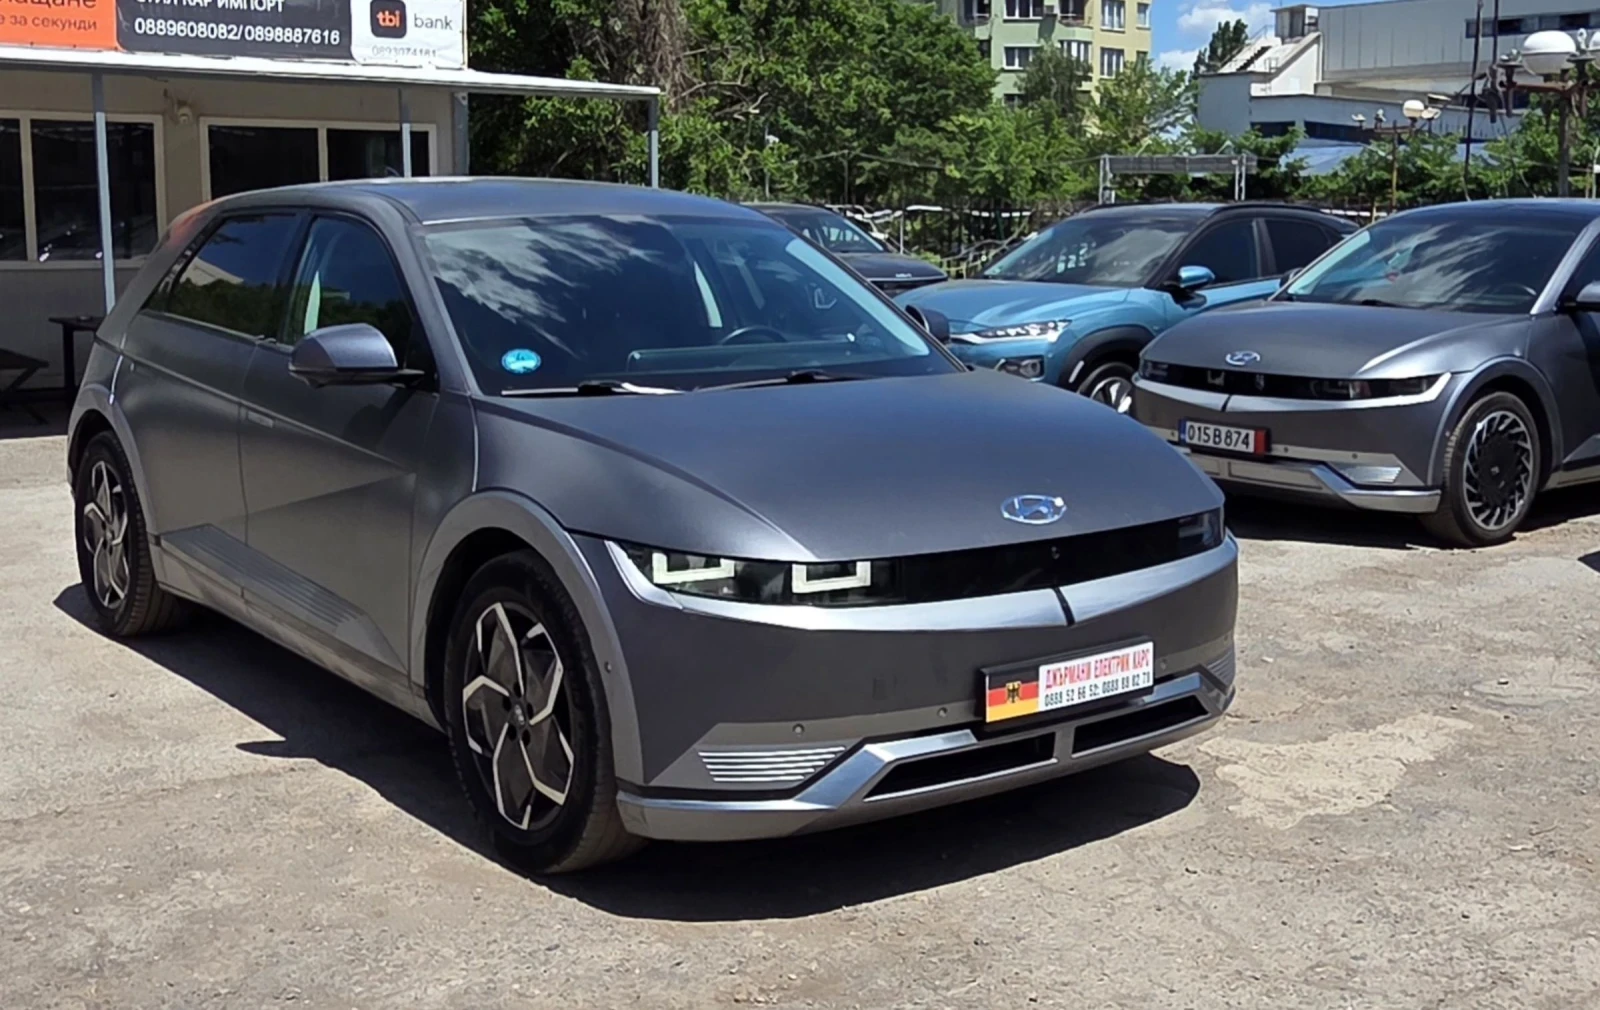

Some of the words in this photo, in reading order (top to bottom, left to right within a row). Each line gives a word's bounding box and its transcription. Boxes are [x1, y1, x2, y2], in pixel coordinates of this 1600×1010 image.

[216, 0, 284, 12] ИМПОРТ
[10, 15, 28, 26] за
[32, 16, 97, 31] секунди
[376, 10, 400, 28] tbi
[413, 13, 453, 31] bank
[134, 17, 340, 45] 0889608082/0898887616
